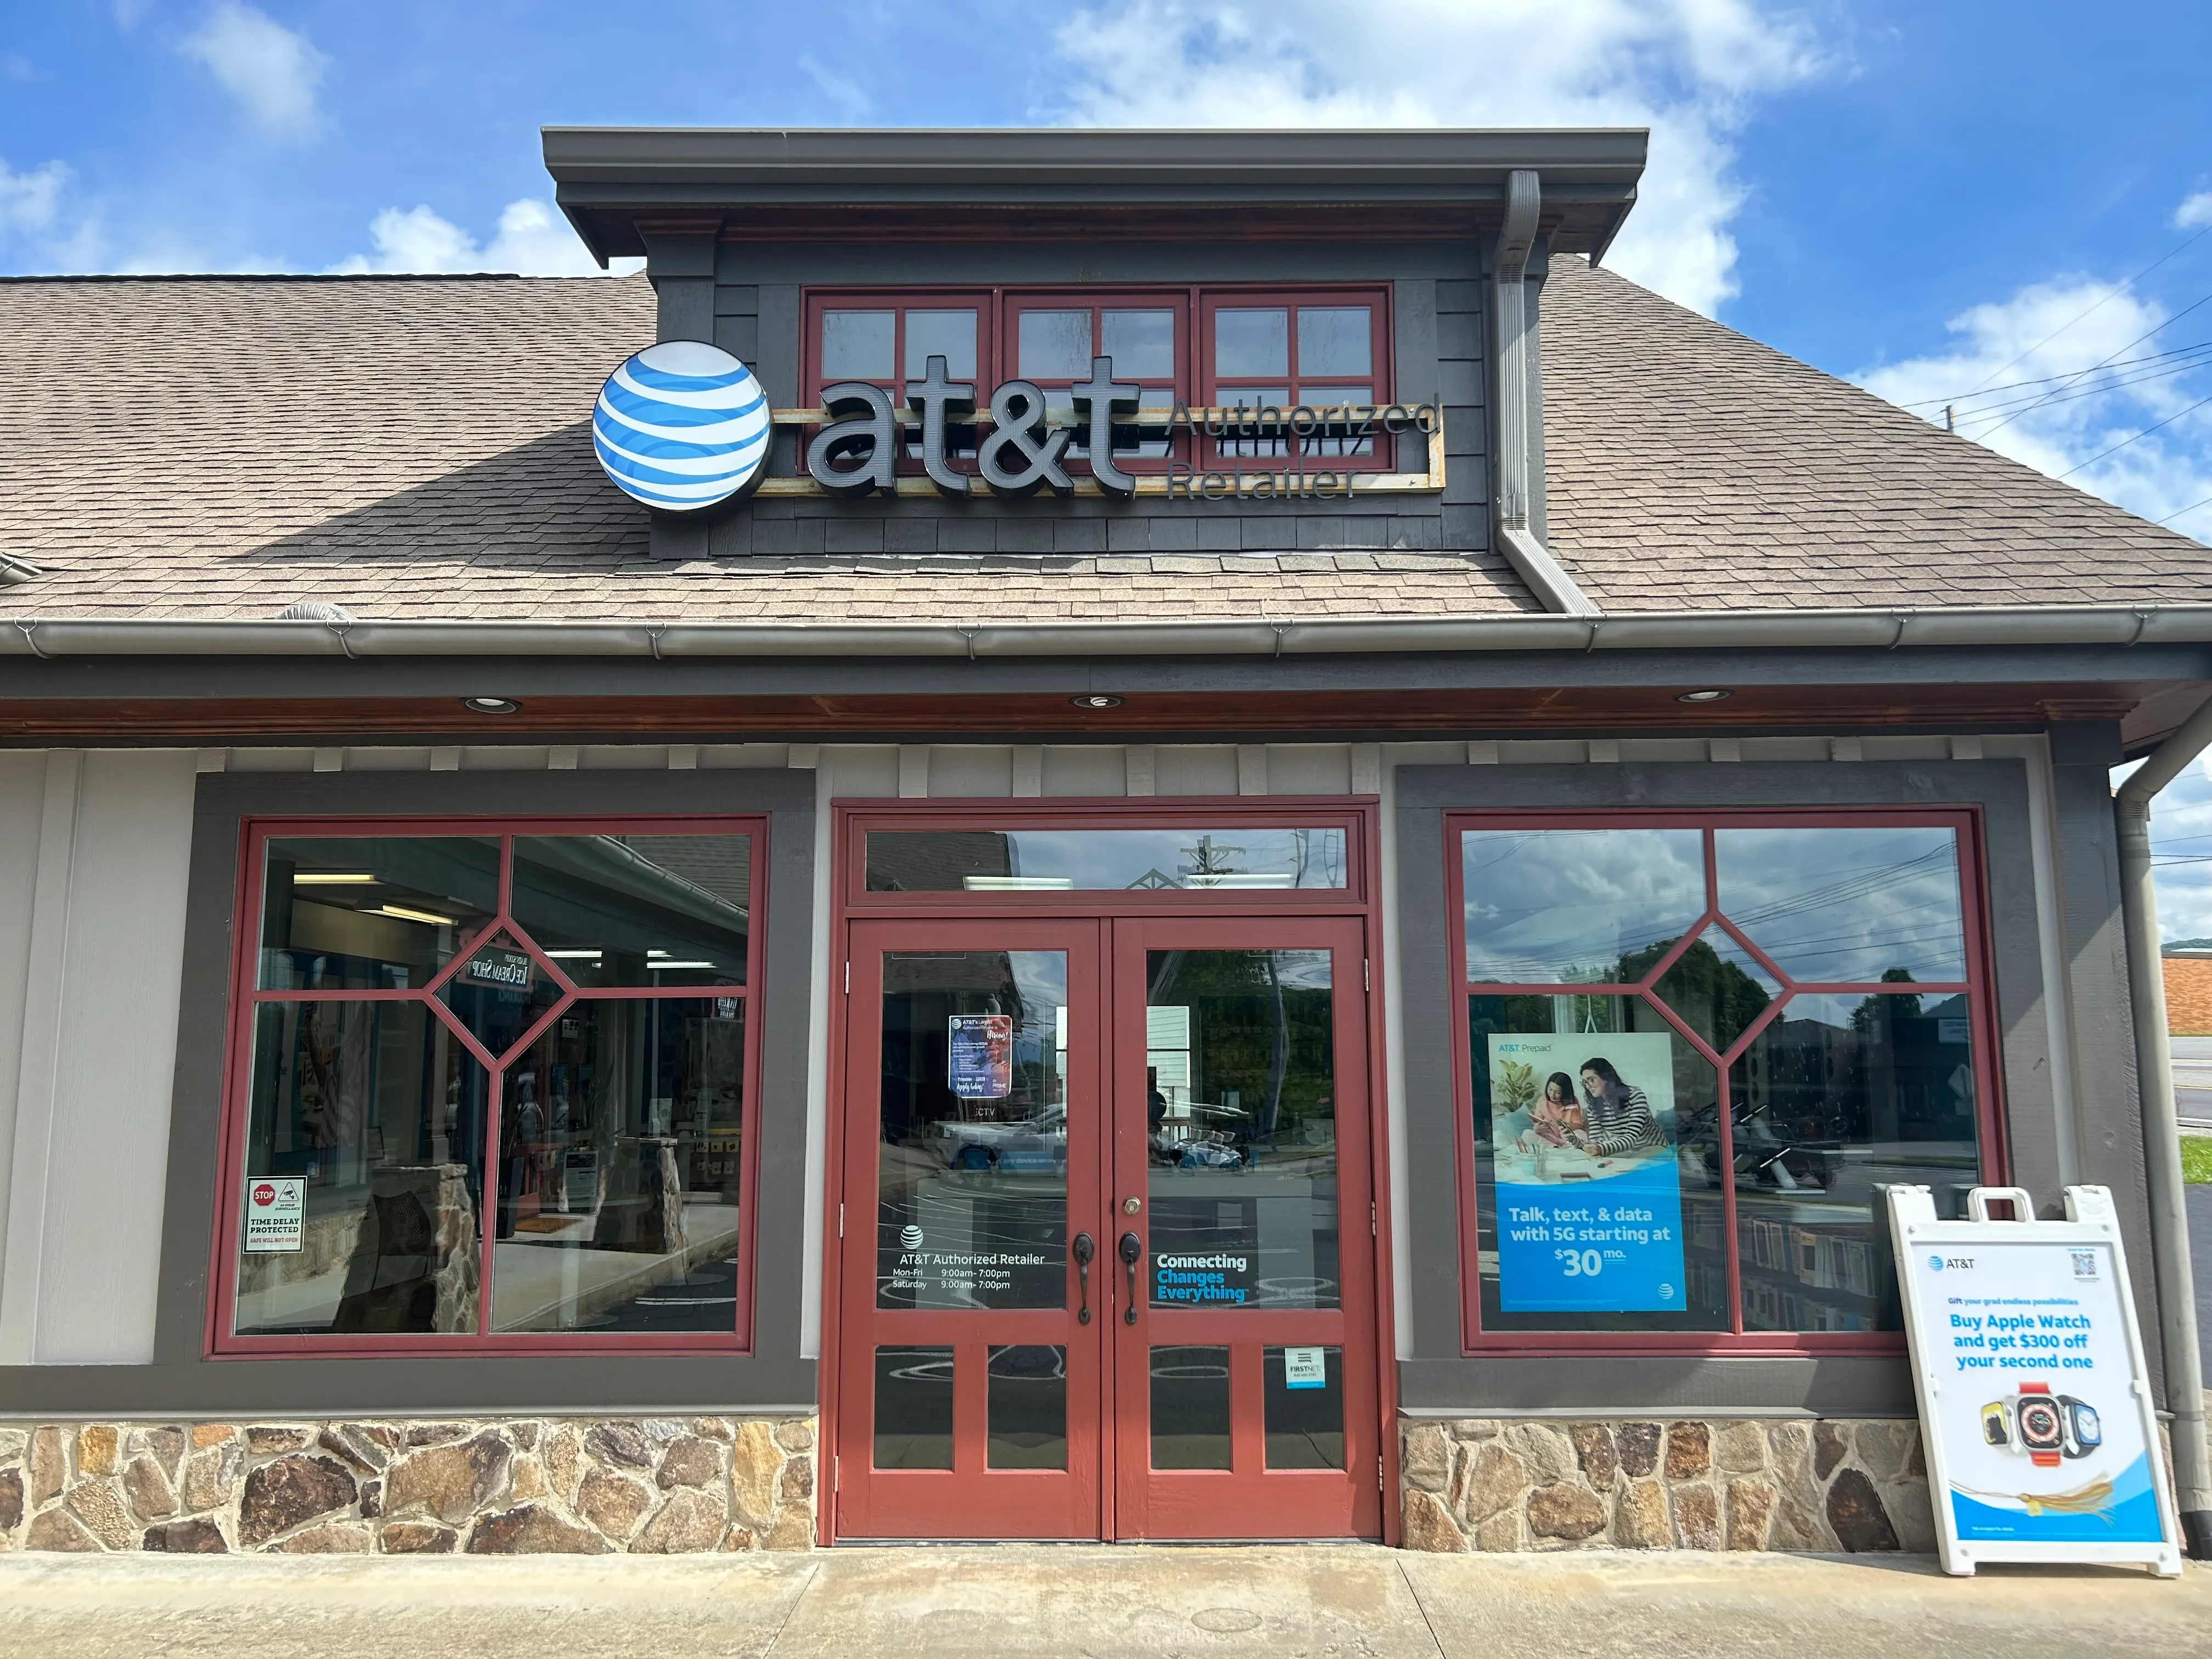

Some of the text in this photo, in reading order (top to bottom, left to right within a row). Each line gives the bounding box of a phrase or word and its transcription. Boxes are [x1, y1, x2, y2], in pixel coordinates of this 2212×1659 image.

[1164, 392, 1441, 437] Authorized
[807, 355, 1141, 499] at&t
[1167, 459, 1363, 501] Retailer
[1522, 1044, 1551, 1053] Prepaid
[956, 1082, 969, 1093] Apply
[255, 1191, 274, 1199] STOP
[1509, 1207, 1652, 1224] Talk, text, & data
[1510, 1226, 1671, 1244] with 5G starting at
[899, 1253, 1045, 1265] AT&T Authorized Retailer
[1157, 1253, 1247, 1272] Connecting
[1554, 1248, 1602, 1277] $30
[1946, 1259, 1974, 1268] AT&T
[893, 1268, 923, 1276] Mon-Fri
[979, 1269, 1010, 1279] 7:00pm
[1157, 1269, 1224, 1287] Changes
[893, 1280, 927, 1289] Saturday
[979, 1280, 1010, 1290] 7:00pm
[1158, 1284, 1245, 1303] Everything
[1950, 1314, 2092, 1331] Buy Apple Watch
[1954, 1334, 2088, 1351] and get $300 off
[1956, 1354, 2094, 1370] your second one
